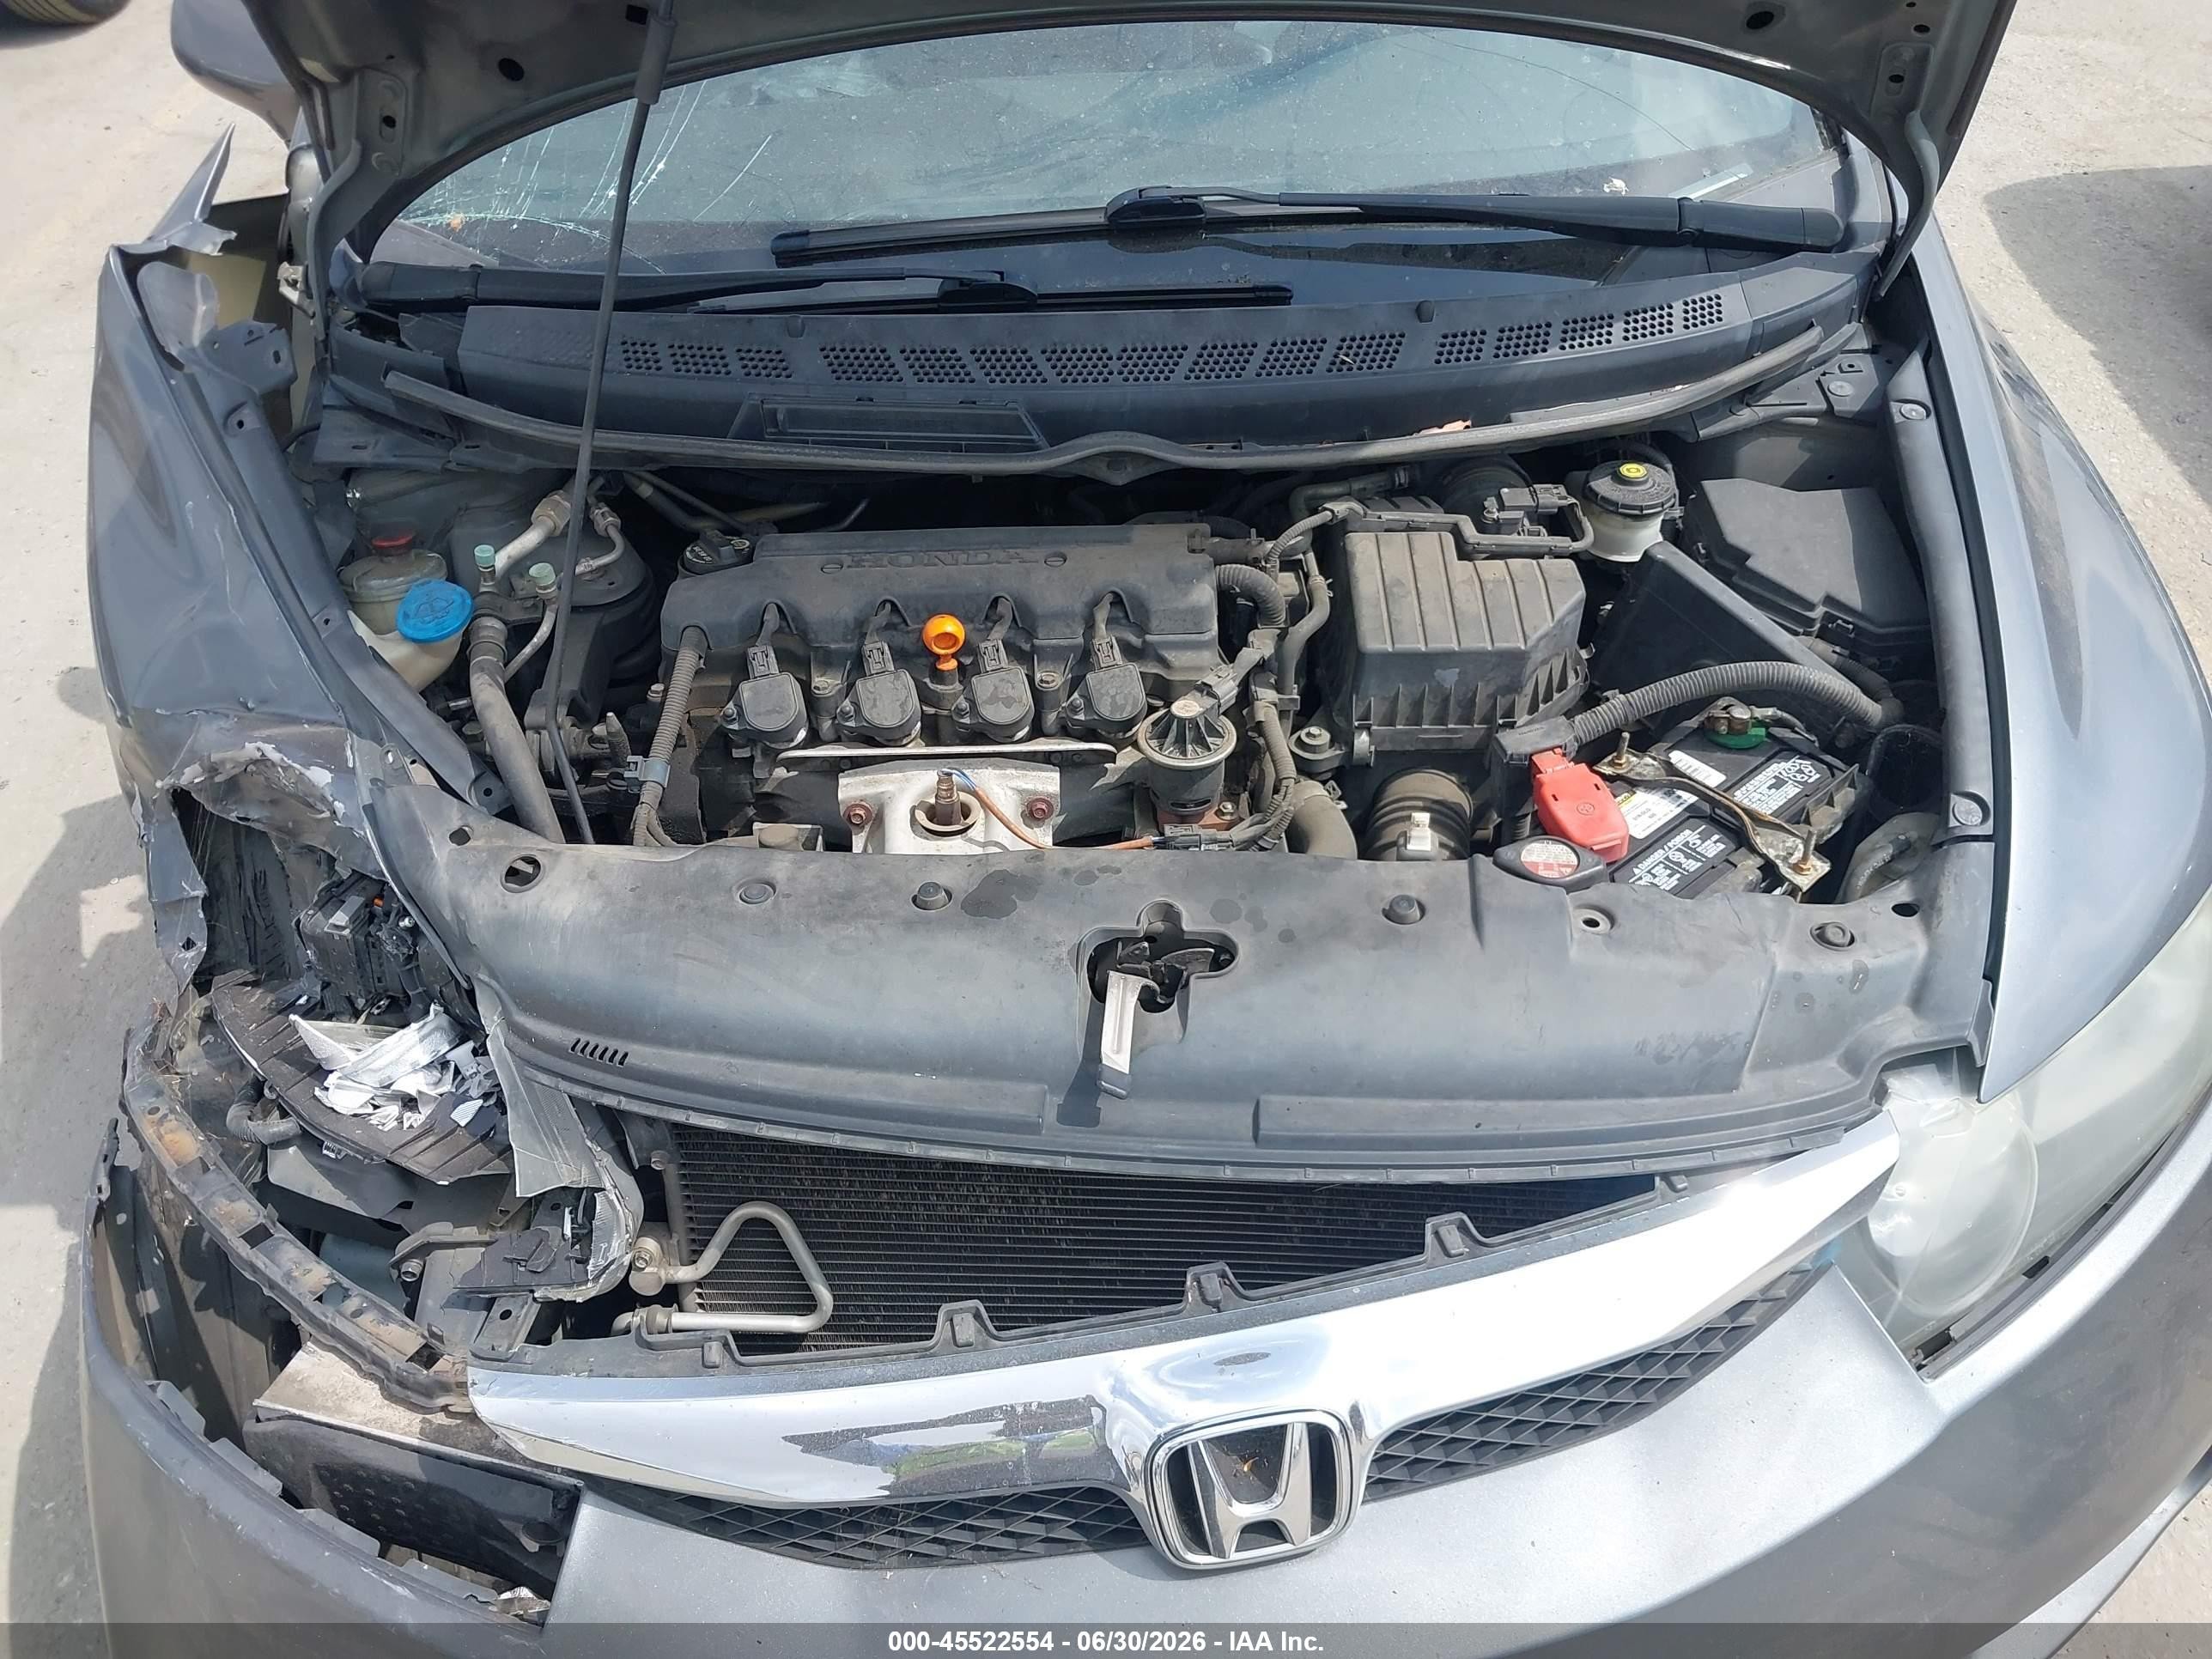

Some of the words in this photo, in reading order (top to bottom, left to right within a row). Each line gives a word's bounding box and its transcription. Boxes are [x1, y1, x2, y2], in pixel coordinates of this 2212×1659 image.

[847, 550, 1039, 568] HONDA
[1637, 848, 1666, 870] DANGER
[1667, 829, 1693, 848] POISON
